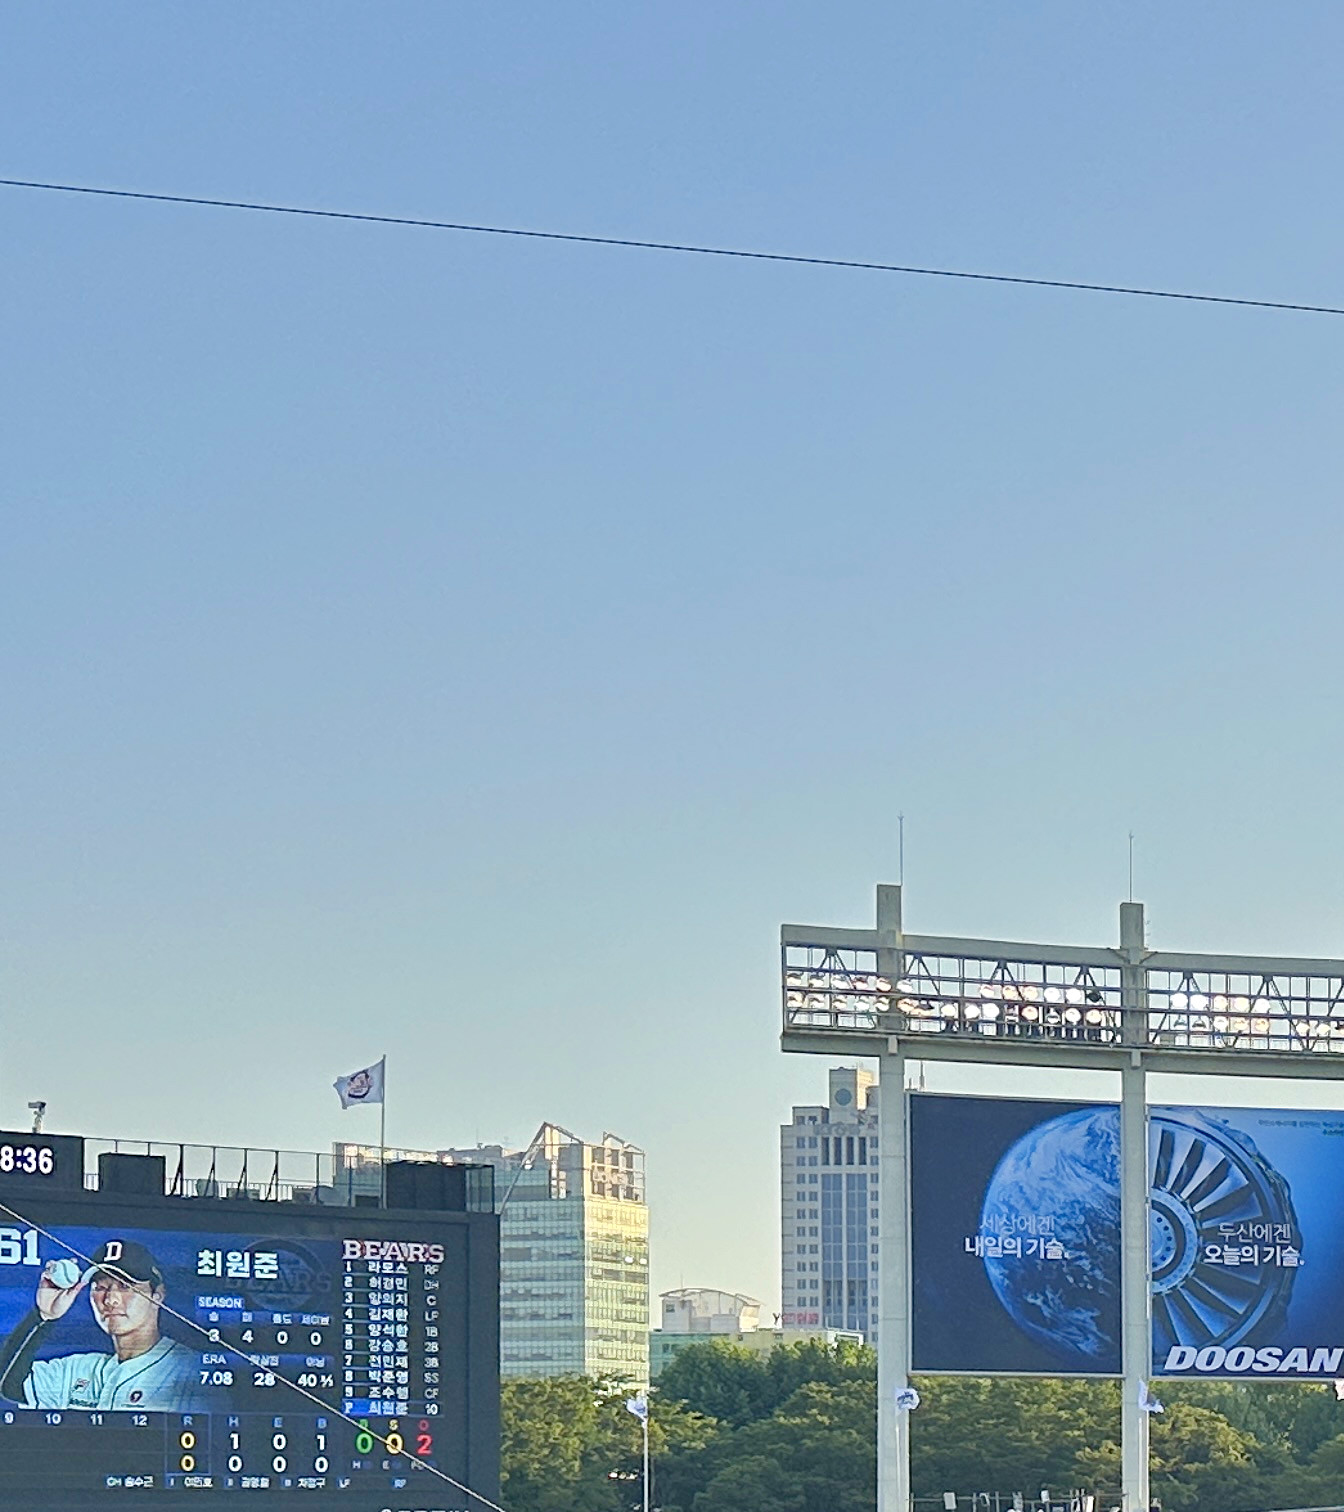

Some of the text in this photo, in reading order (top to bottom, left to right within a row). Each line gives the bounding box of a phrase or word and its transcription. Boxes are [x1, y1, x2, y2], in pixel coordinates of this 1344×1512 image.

[980, 1213, 1055, 1236] 세상에겐
[1217, 1222, 1291, 1246] 두산에겐
[342, 1240, 445, 1263] BEARS
[964, 1236, 1070, 1260] 내일의 기술.
[1203, 1245, 1305, 1267] 오늘의 기술.
[197, 1250, 279, 1279] 최원준
[198, 1297, 242, 1308] SEASON
[242, 1330, 253, 1343] 4
[277, 1331, 288, 1344] 0
[310, 1332, 321, 1345] 0
[202, 1354, 226, 1364] ERA
[1164, 1345, 1344, 1373] DOOSAN
[200, 1371, 233, 1385] 7.08
[254, 1372, 275, 1386] 28
[298, 1374, 317, 1387] 40
[5, 1413, 13, 1424] 9
[46, 1414, 61, 1425] 10
[91, 1414, 103, 1425] 11
[132, 1415, 147, 1426] 12
[183, 1417, 192, 1427] R
[229, 1417, 239, 1427] H
[273, 1417, 282, 1428] E
[180, 1432, 325, 1451] 0 1 0 1
[355, 1433, 373, 1453] 0
[417, 1434, 432, 1454] 2
[181, 1455, 328, 1473] 0 0 0 0
